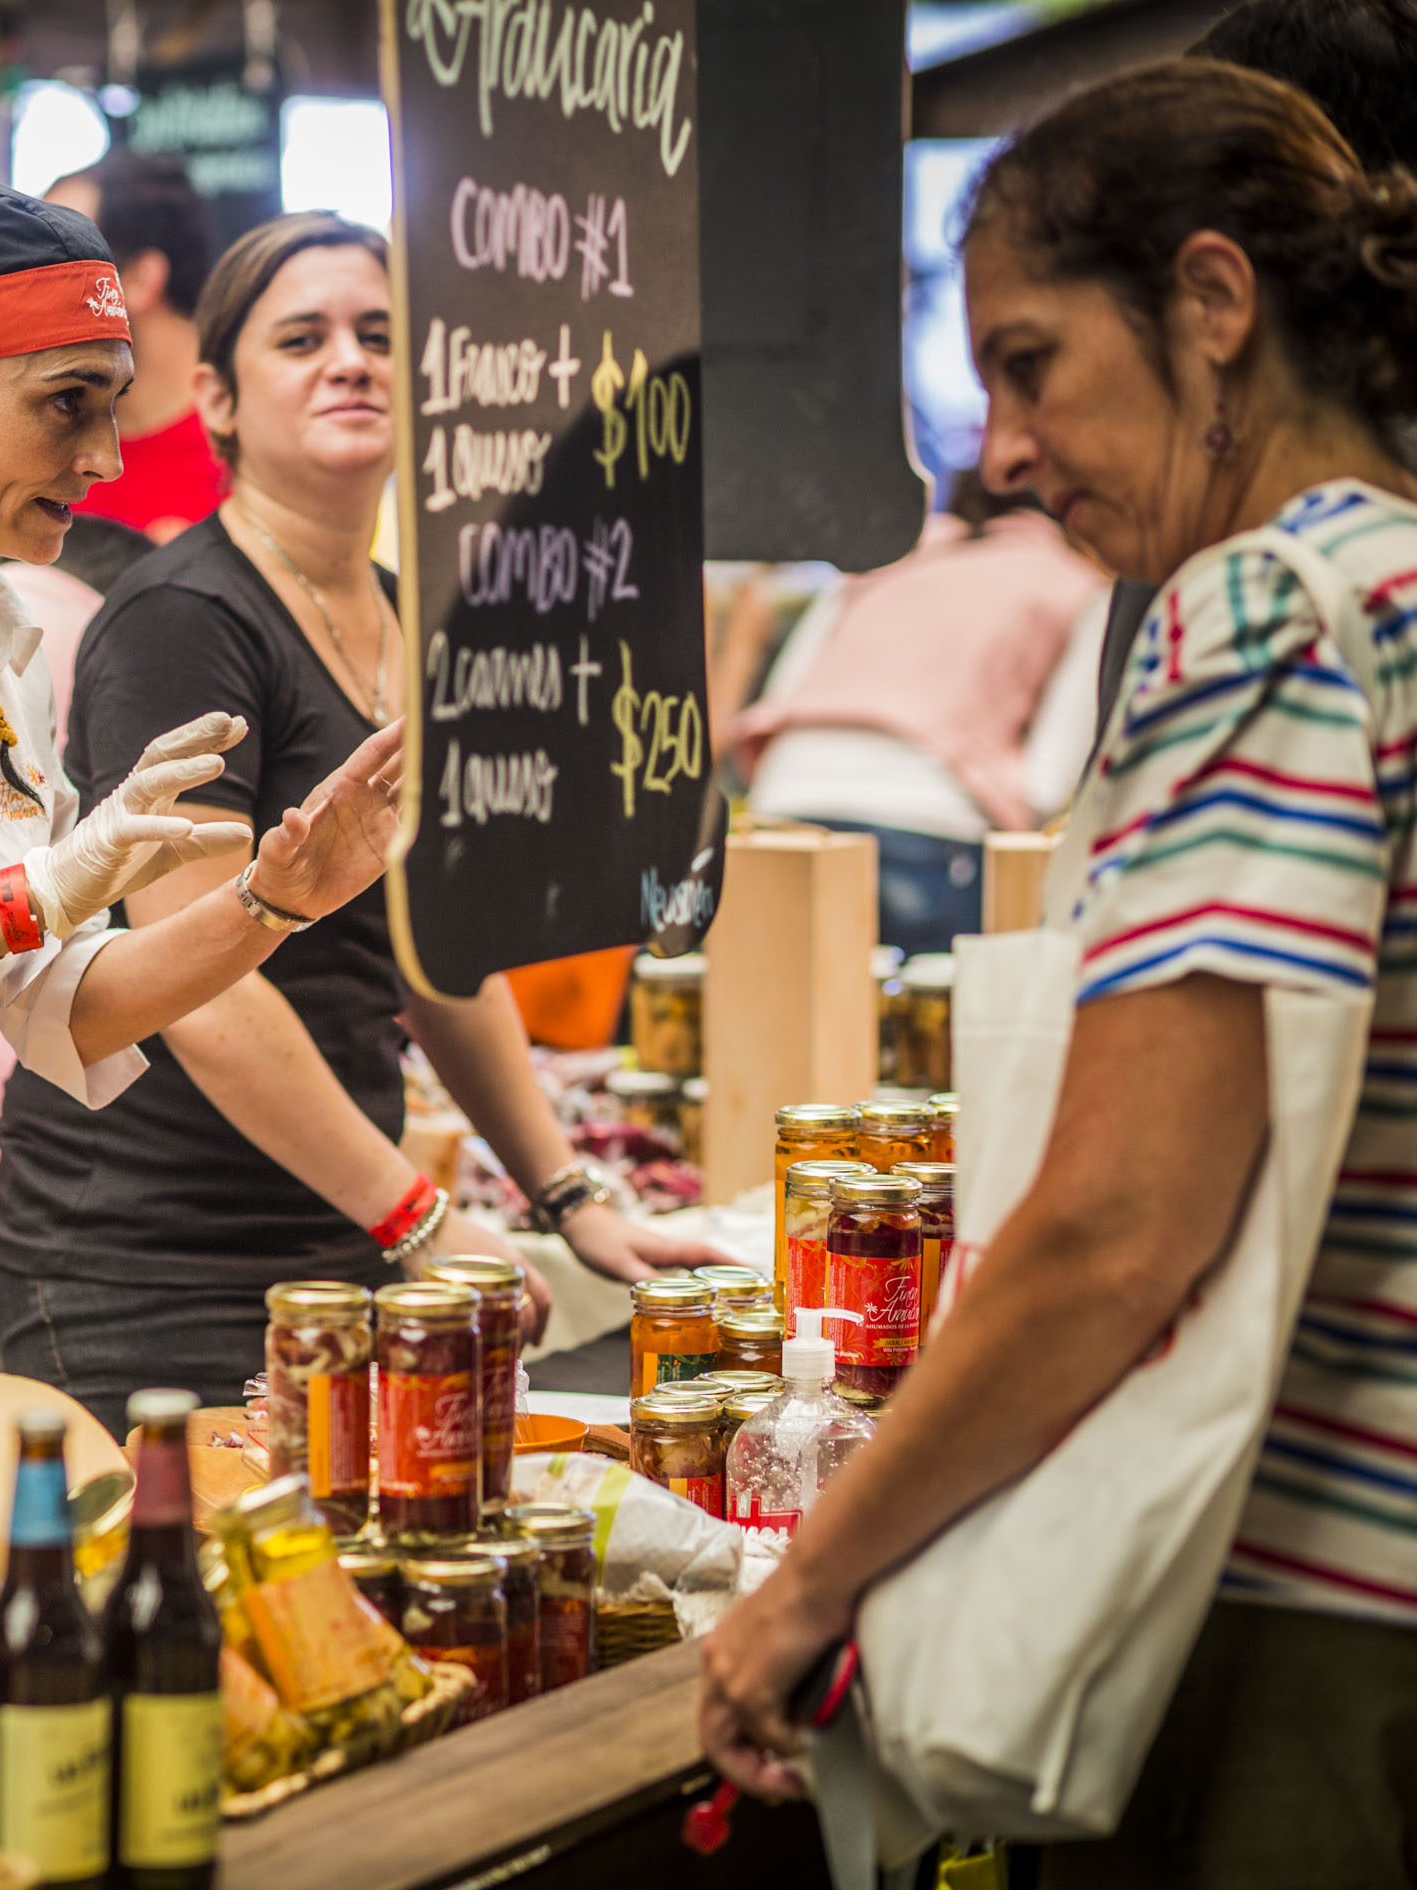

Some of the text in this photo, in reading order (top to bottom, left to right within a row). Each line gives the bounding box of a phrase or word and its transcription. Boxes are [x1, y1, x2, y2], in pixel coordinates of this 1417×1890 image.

[574, 192, 634, 302] #1
[592, 329, 691, 489] $100
[422, 423, 457, 513] 1
[582, 512, 640, 622] #2
[426, 630, 461, 723] 2
[611, 637, 702, 818] $250
[439, 736, 463, 828] 1
